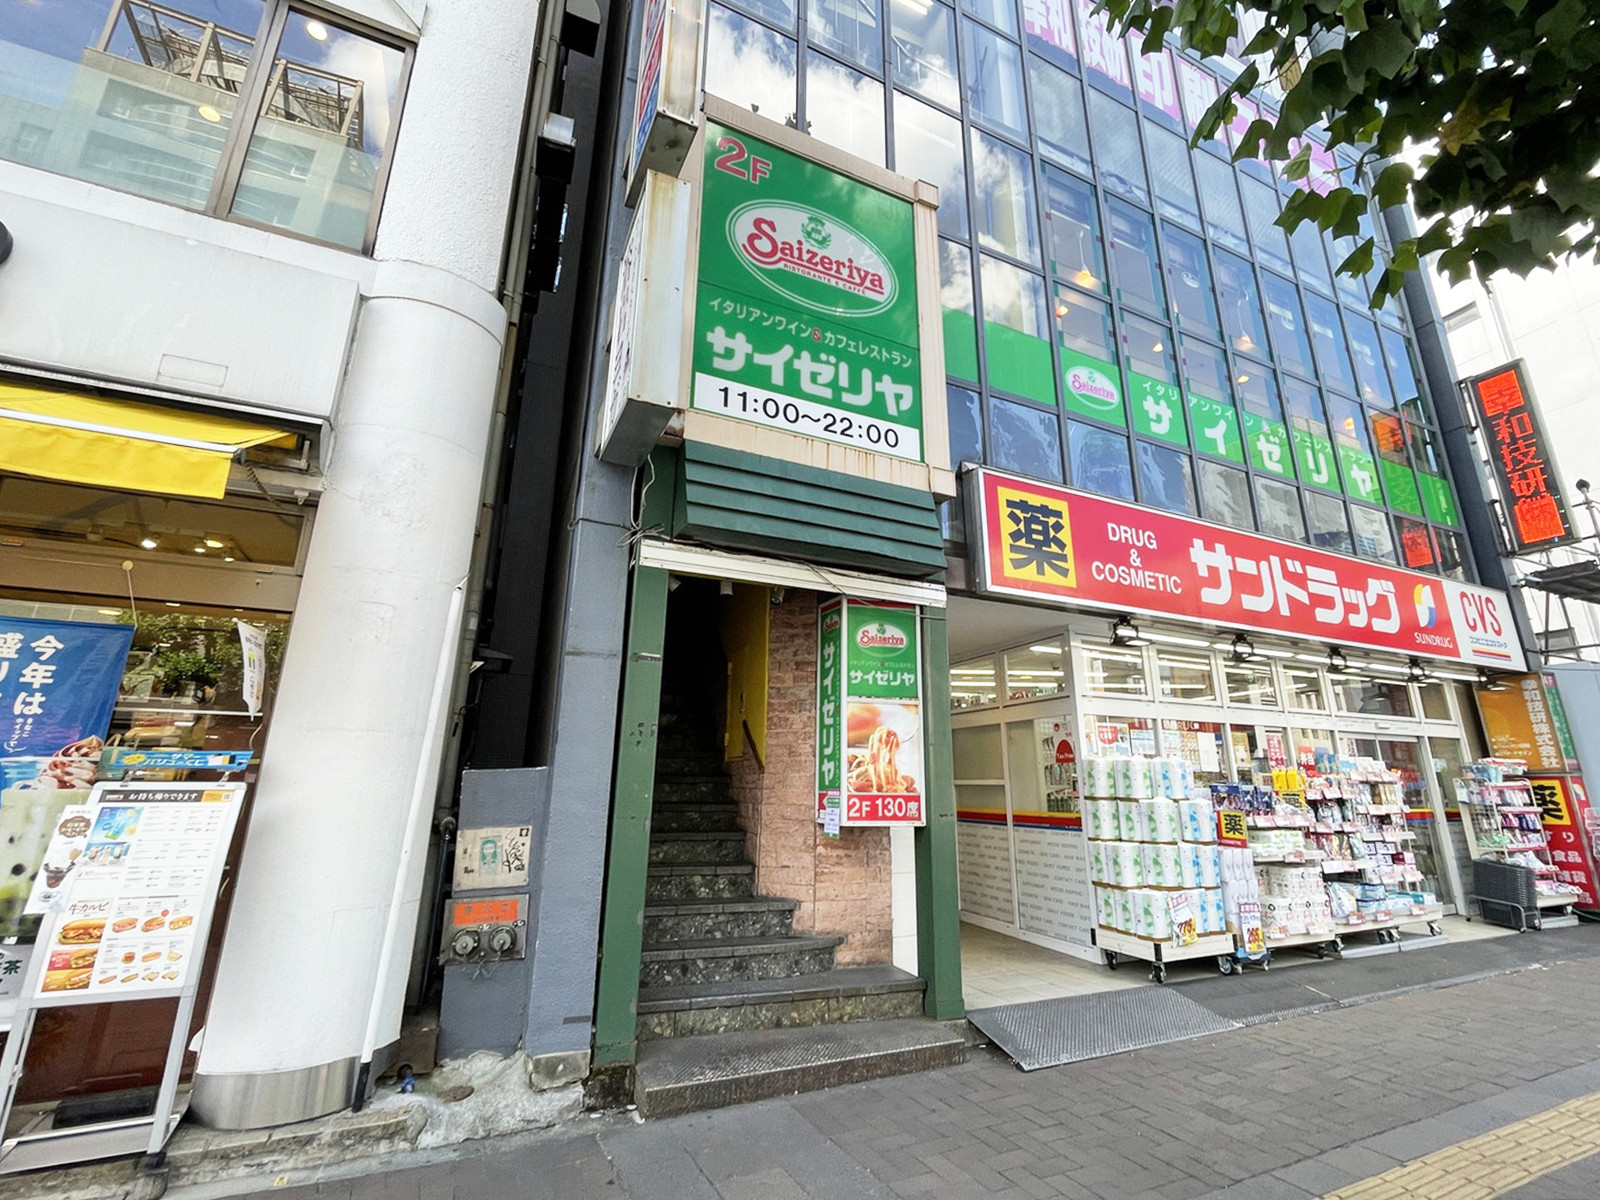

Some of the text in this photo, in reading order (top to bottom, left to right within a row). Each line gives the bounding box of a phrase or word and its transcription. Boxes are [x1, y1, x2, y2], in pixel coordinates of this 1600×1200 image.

[715, 137, 771, 184] 2F
[742, 217, 885, 295] Saizeriya
[783, 263, 831, 284] RISTORANTE
[706, 326, 913, 417] サイゼリヤ
[1071, 374, 1116, 400] Saizeriya
[1142, 394, 1373, 497] サイゼリヤ
[1005, 498, 1070, 578] 薬
[1107, 522, 1157, 550] DRUG
[1129, 548, 1143, 567] &
[1091, 561, 1182, 595] COSMETIC
[1189, 537, 1400, 634] サンドラッグ
[1459, 591, 1502, 637] CVS
[859, 629, 905, 646] Saizeriya
[1414, 632, 1453, 648] SUNDRUG
[13, 634, 65, 715] 今年は
[849, 670, 915, 687] サイゼリヤ
[821, 641, 836, 787] サイゼリヤ
[848, 797, 871, 817] 2F
[875, 797, 919, 818] 130席
[1223, 814, 1244, 835] 薬
[69, 901, 110, 915] 牛カルビ
[0, 959, 23, 975] 茶
